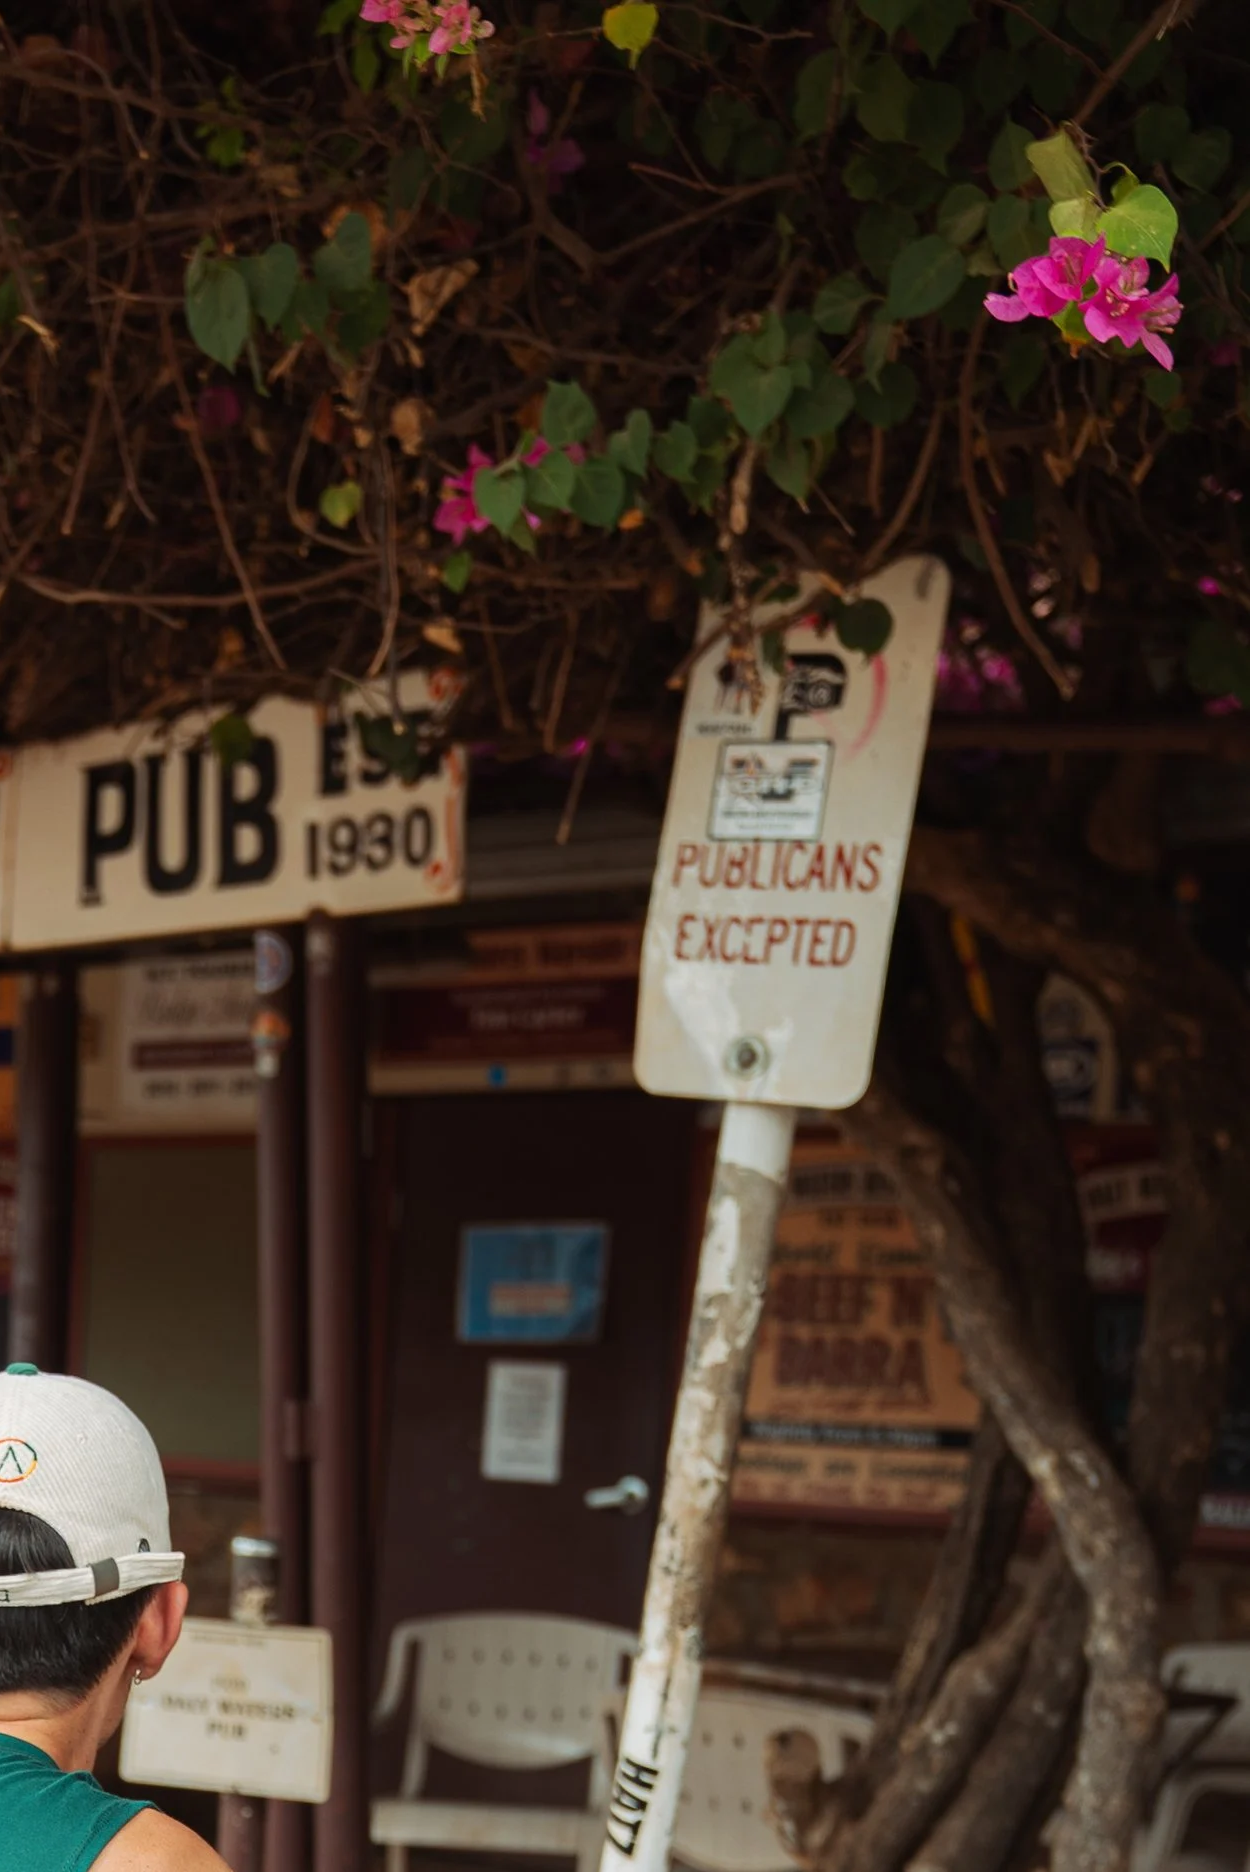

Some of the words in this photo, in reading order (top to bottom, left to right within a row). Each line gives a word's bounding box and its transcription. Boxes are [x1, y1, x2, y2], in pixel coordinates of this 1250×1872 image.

[78, 735, 279, 908] PUB
[306, 805, 432, 881] 1930
[672, 840, 883, 892] PUBLICANS
[674, 913, 857, 967] EXCEPTED
